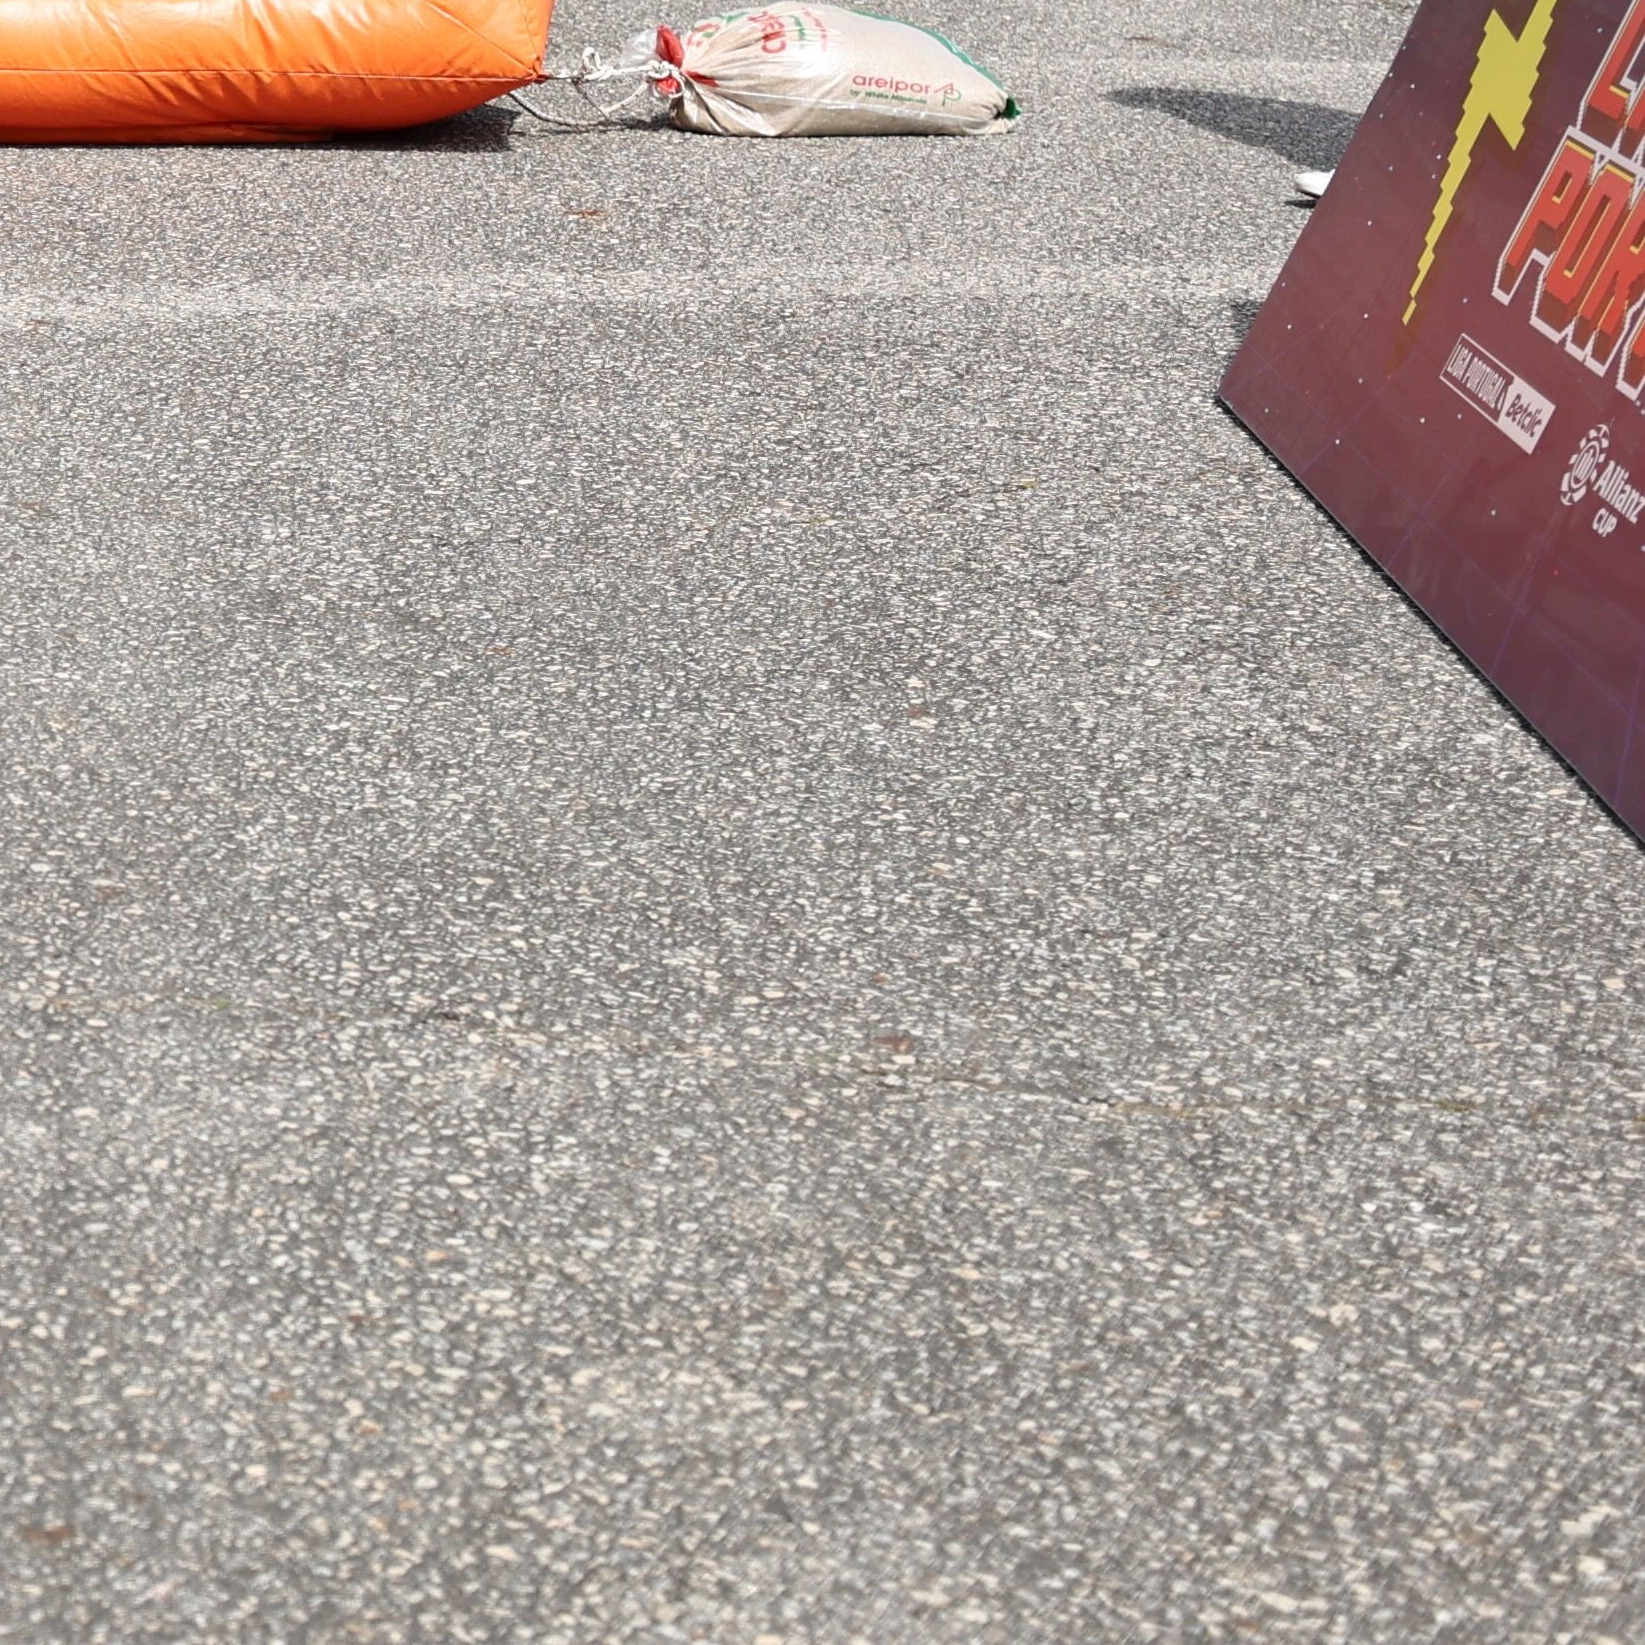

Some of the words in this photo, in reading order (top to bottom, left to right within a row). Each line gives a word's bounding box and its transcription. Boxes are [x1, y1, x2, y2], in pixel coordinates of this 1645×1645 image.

[1447, 343, 1473, 383] LIGA
[1462, 355, 1507, 410] PORTUGAL
[1505, 393, 1543, 438] Betclic
[1591, 507, 1618, 538] CUP
[1592, 459, 1645, 525] Allianz
